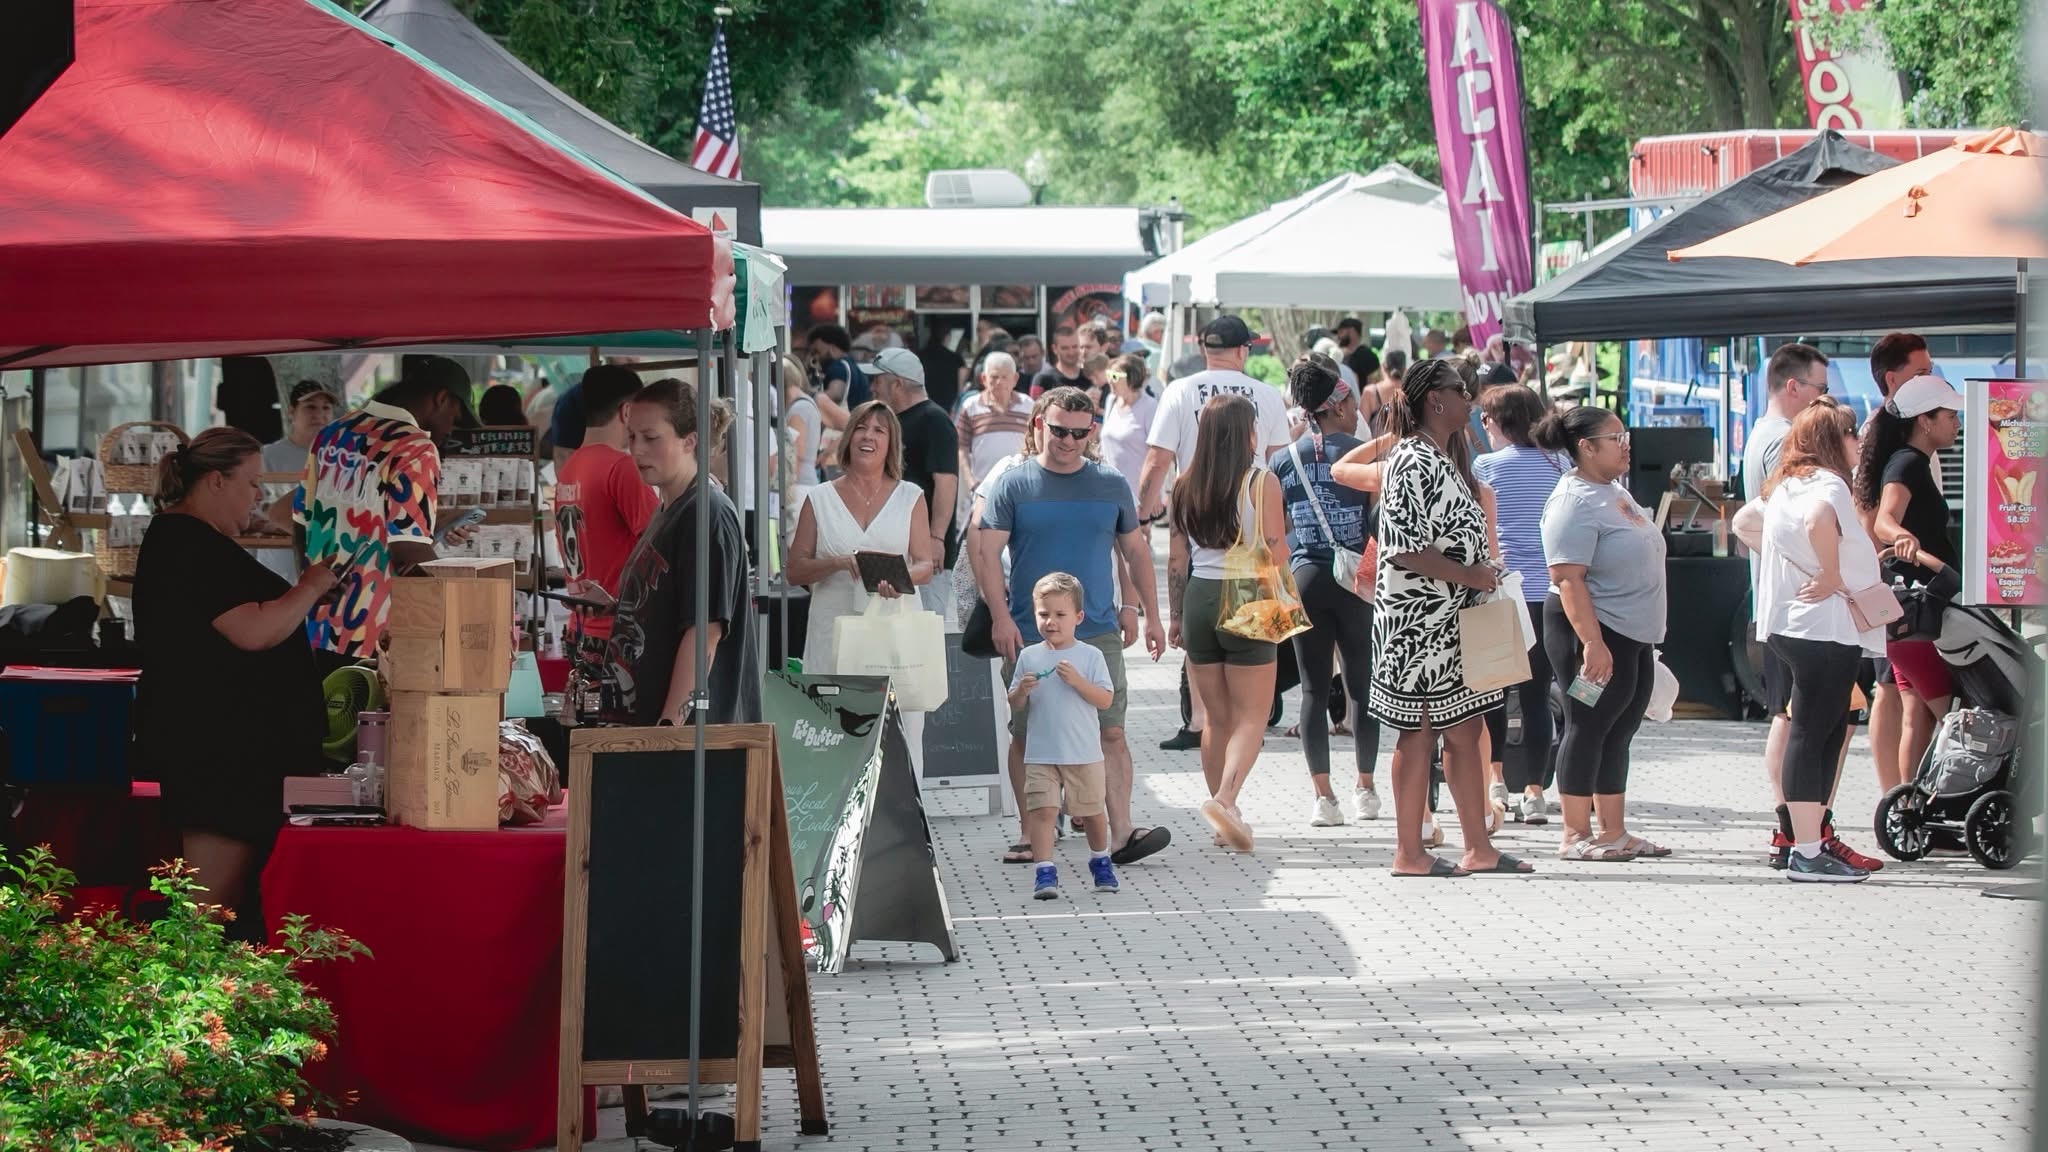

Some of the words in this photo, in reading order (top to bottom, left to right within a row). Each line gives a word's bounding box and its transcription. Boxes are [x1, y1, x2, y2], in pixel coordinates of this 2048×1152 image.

[1450, 2, 1504, 271] ACAI
[1999, 504, 2016, 512] Fruit
[2018, 504, 2037, 513] Cups
[1989, 566, 2004, 574] Hot
[2005, 566, 2037, 575] Cheetos
[2002, 590, 2024, 598] $7.99
[792, 719, 809, 740] Fat
[804, 726, 844, 747] Butter
[786, 781, 832, 814] Local
